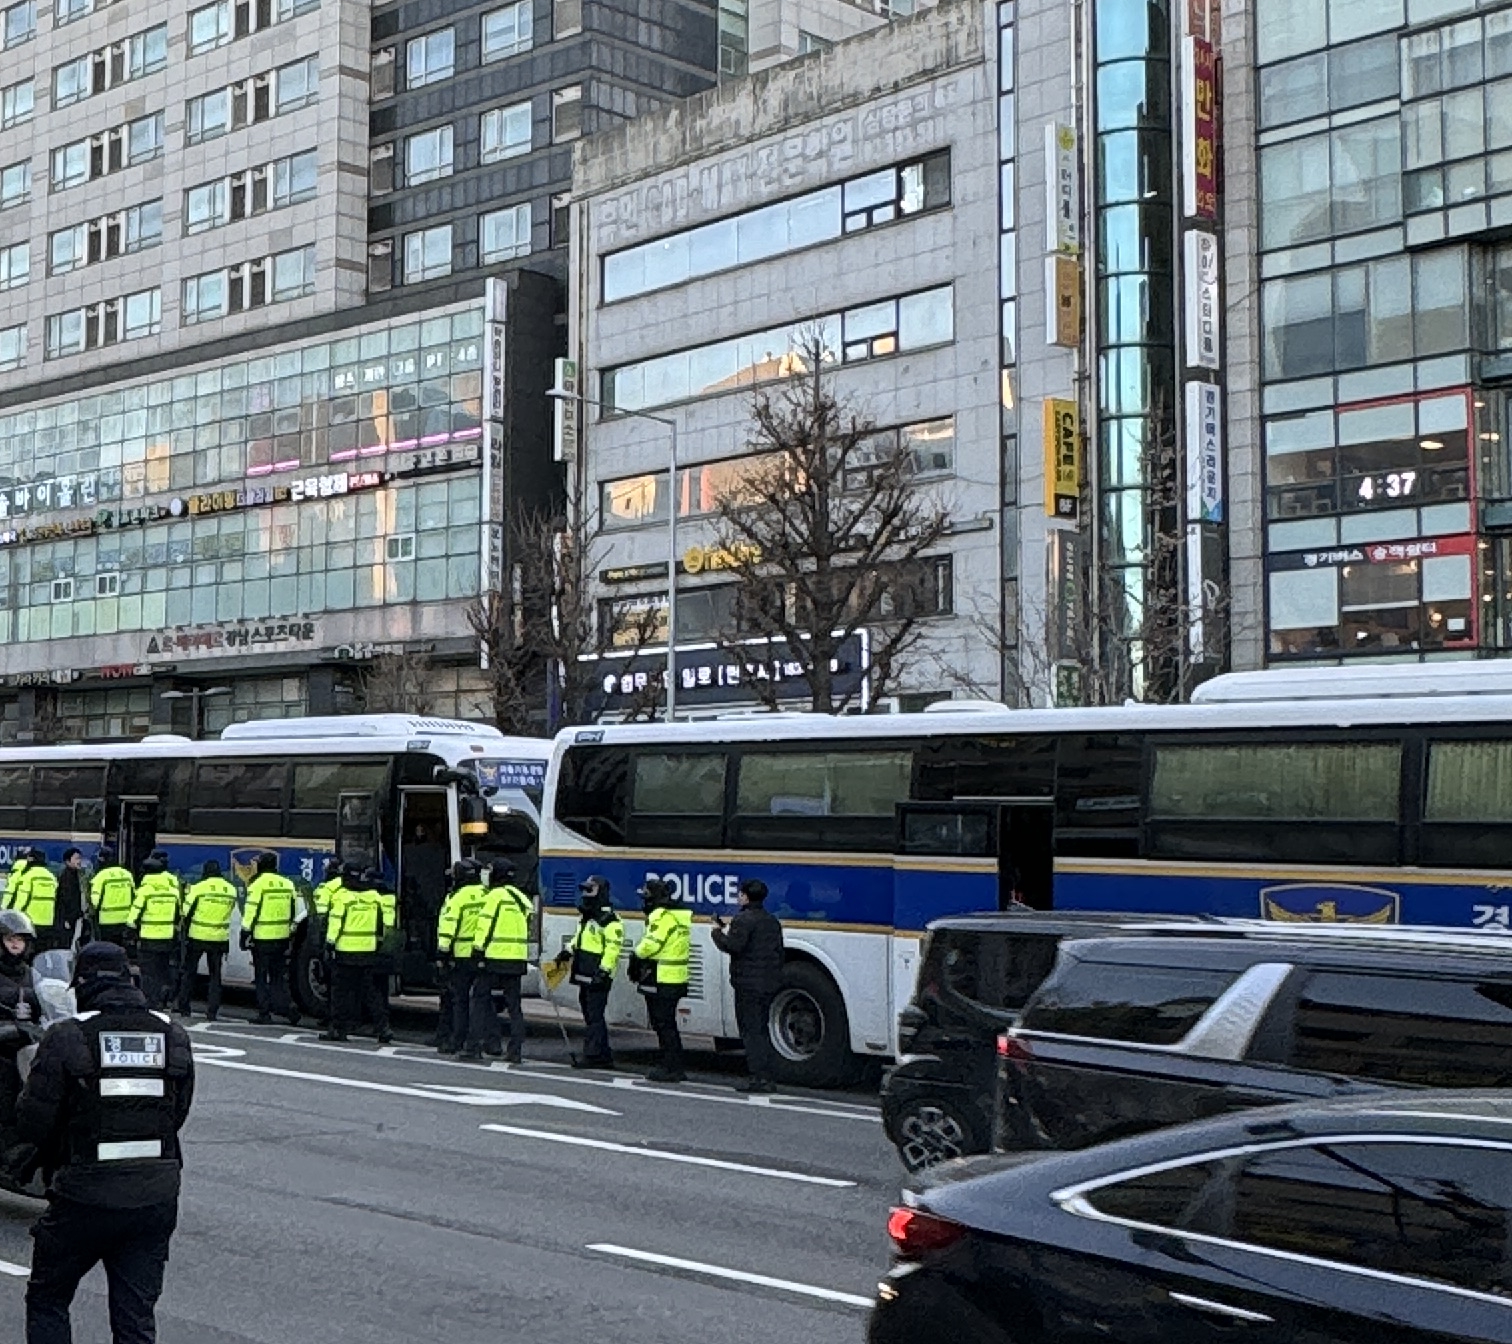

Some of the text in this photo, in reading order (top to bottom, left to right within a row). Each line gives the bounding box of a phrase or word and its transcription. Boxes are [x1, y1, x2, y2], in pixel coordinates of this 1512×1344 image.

[1061, 413, 1075, 467] CAFE
[1358, 470, 1417, 500] 4:37
[645, 872, 740, 905] OLICE
[109, 1053, 161, 1065] POLICE
